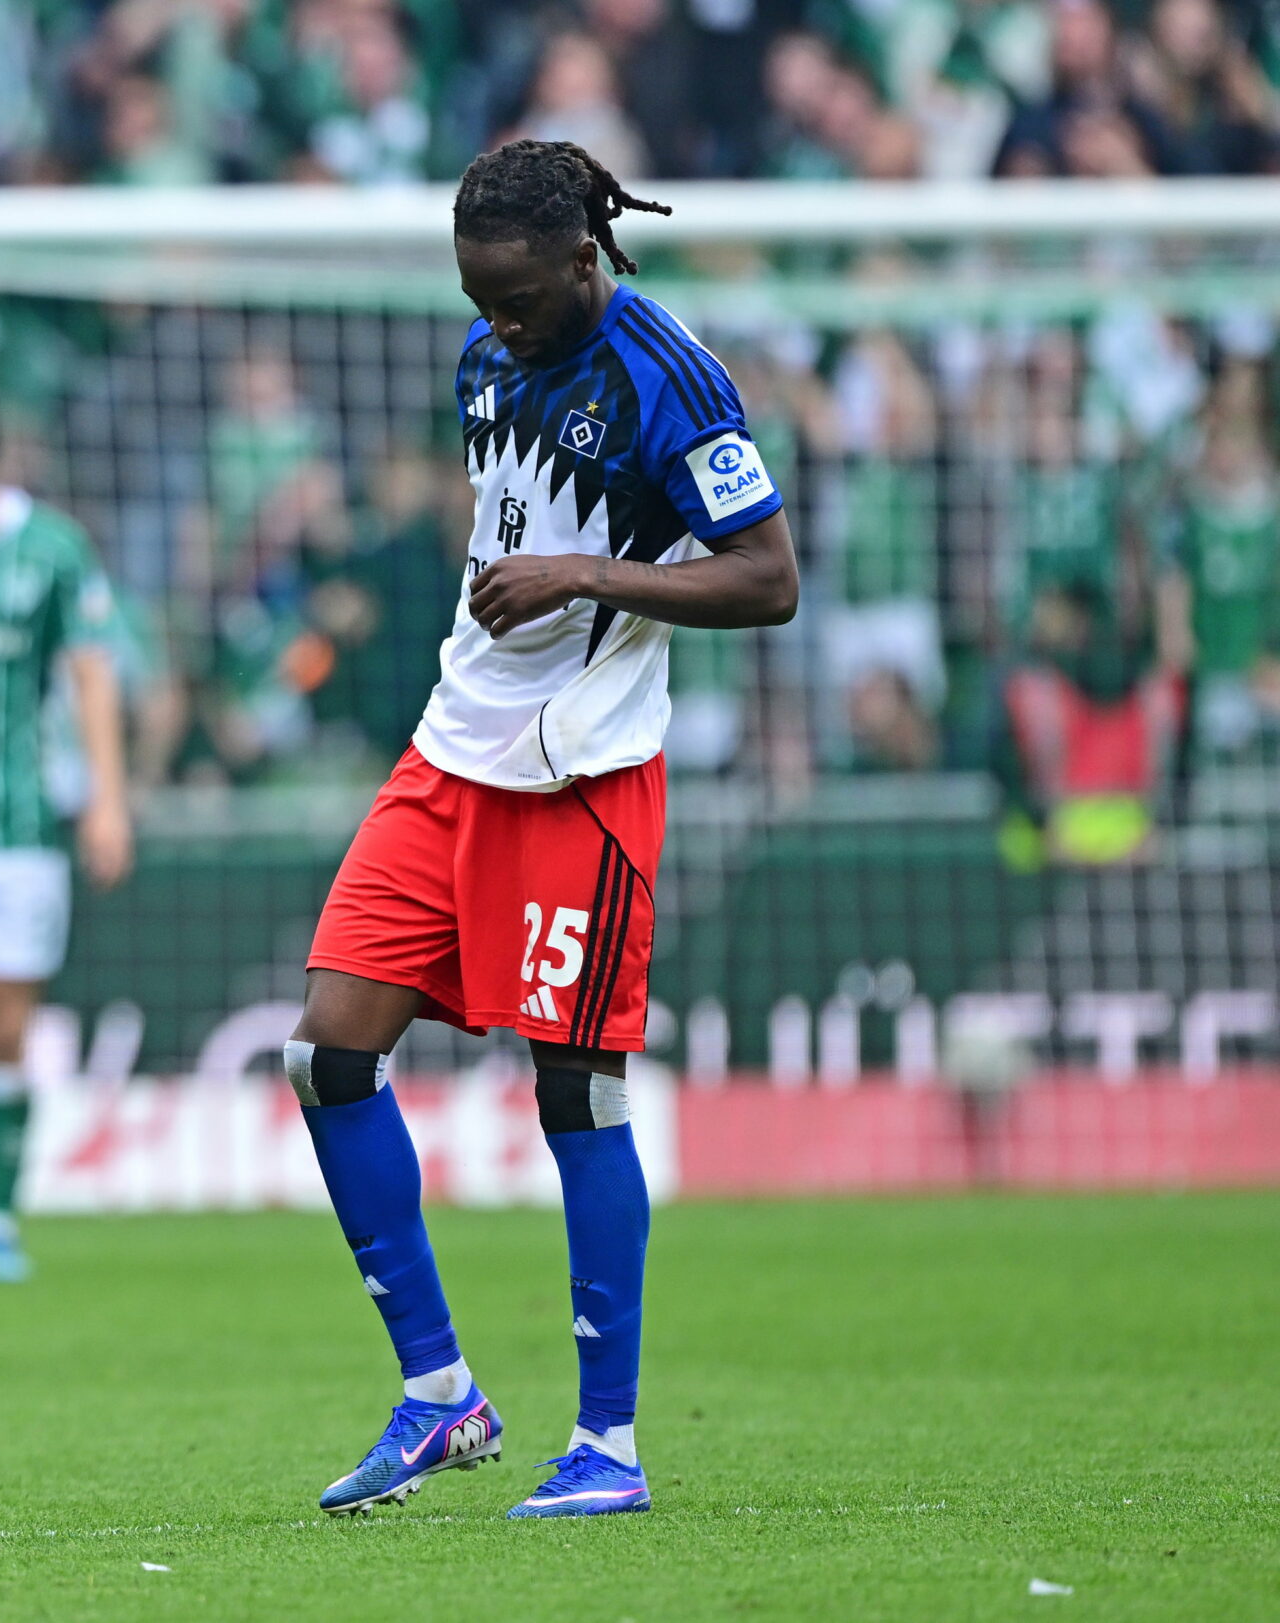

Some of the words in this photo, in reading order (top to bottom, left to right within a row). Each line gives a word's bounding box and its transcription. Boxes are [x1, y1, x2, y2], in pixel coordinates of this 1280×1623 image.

[712, 467, 761, 500] PLAN
[719, 483, 764, 507] INTERNATIONAL
[521, 902, 589, 987] 25
